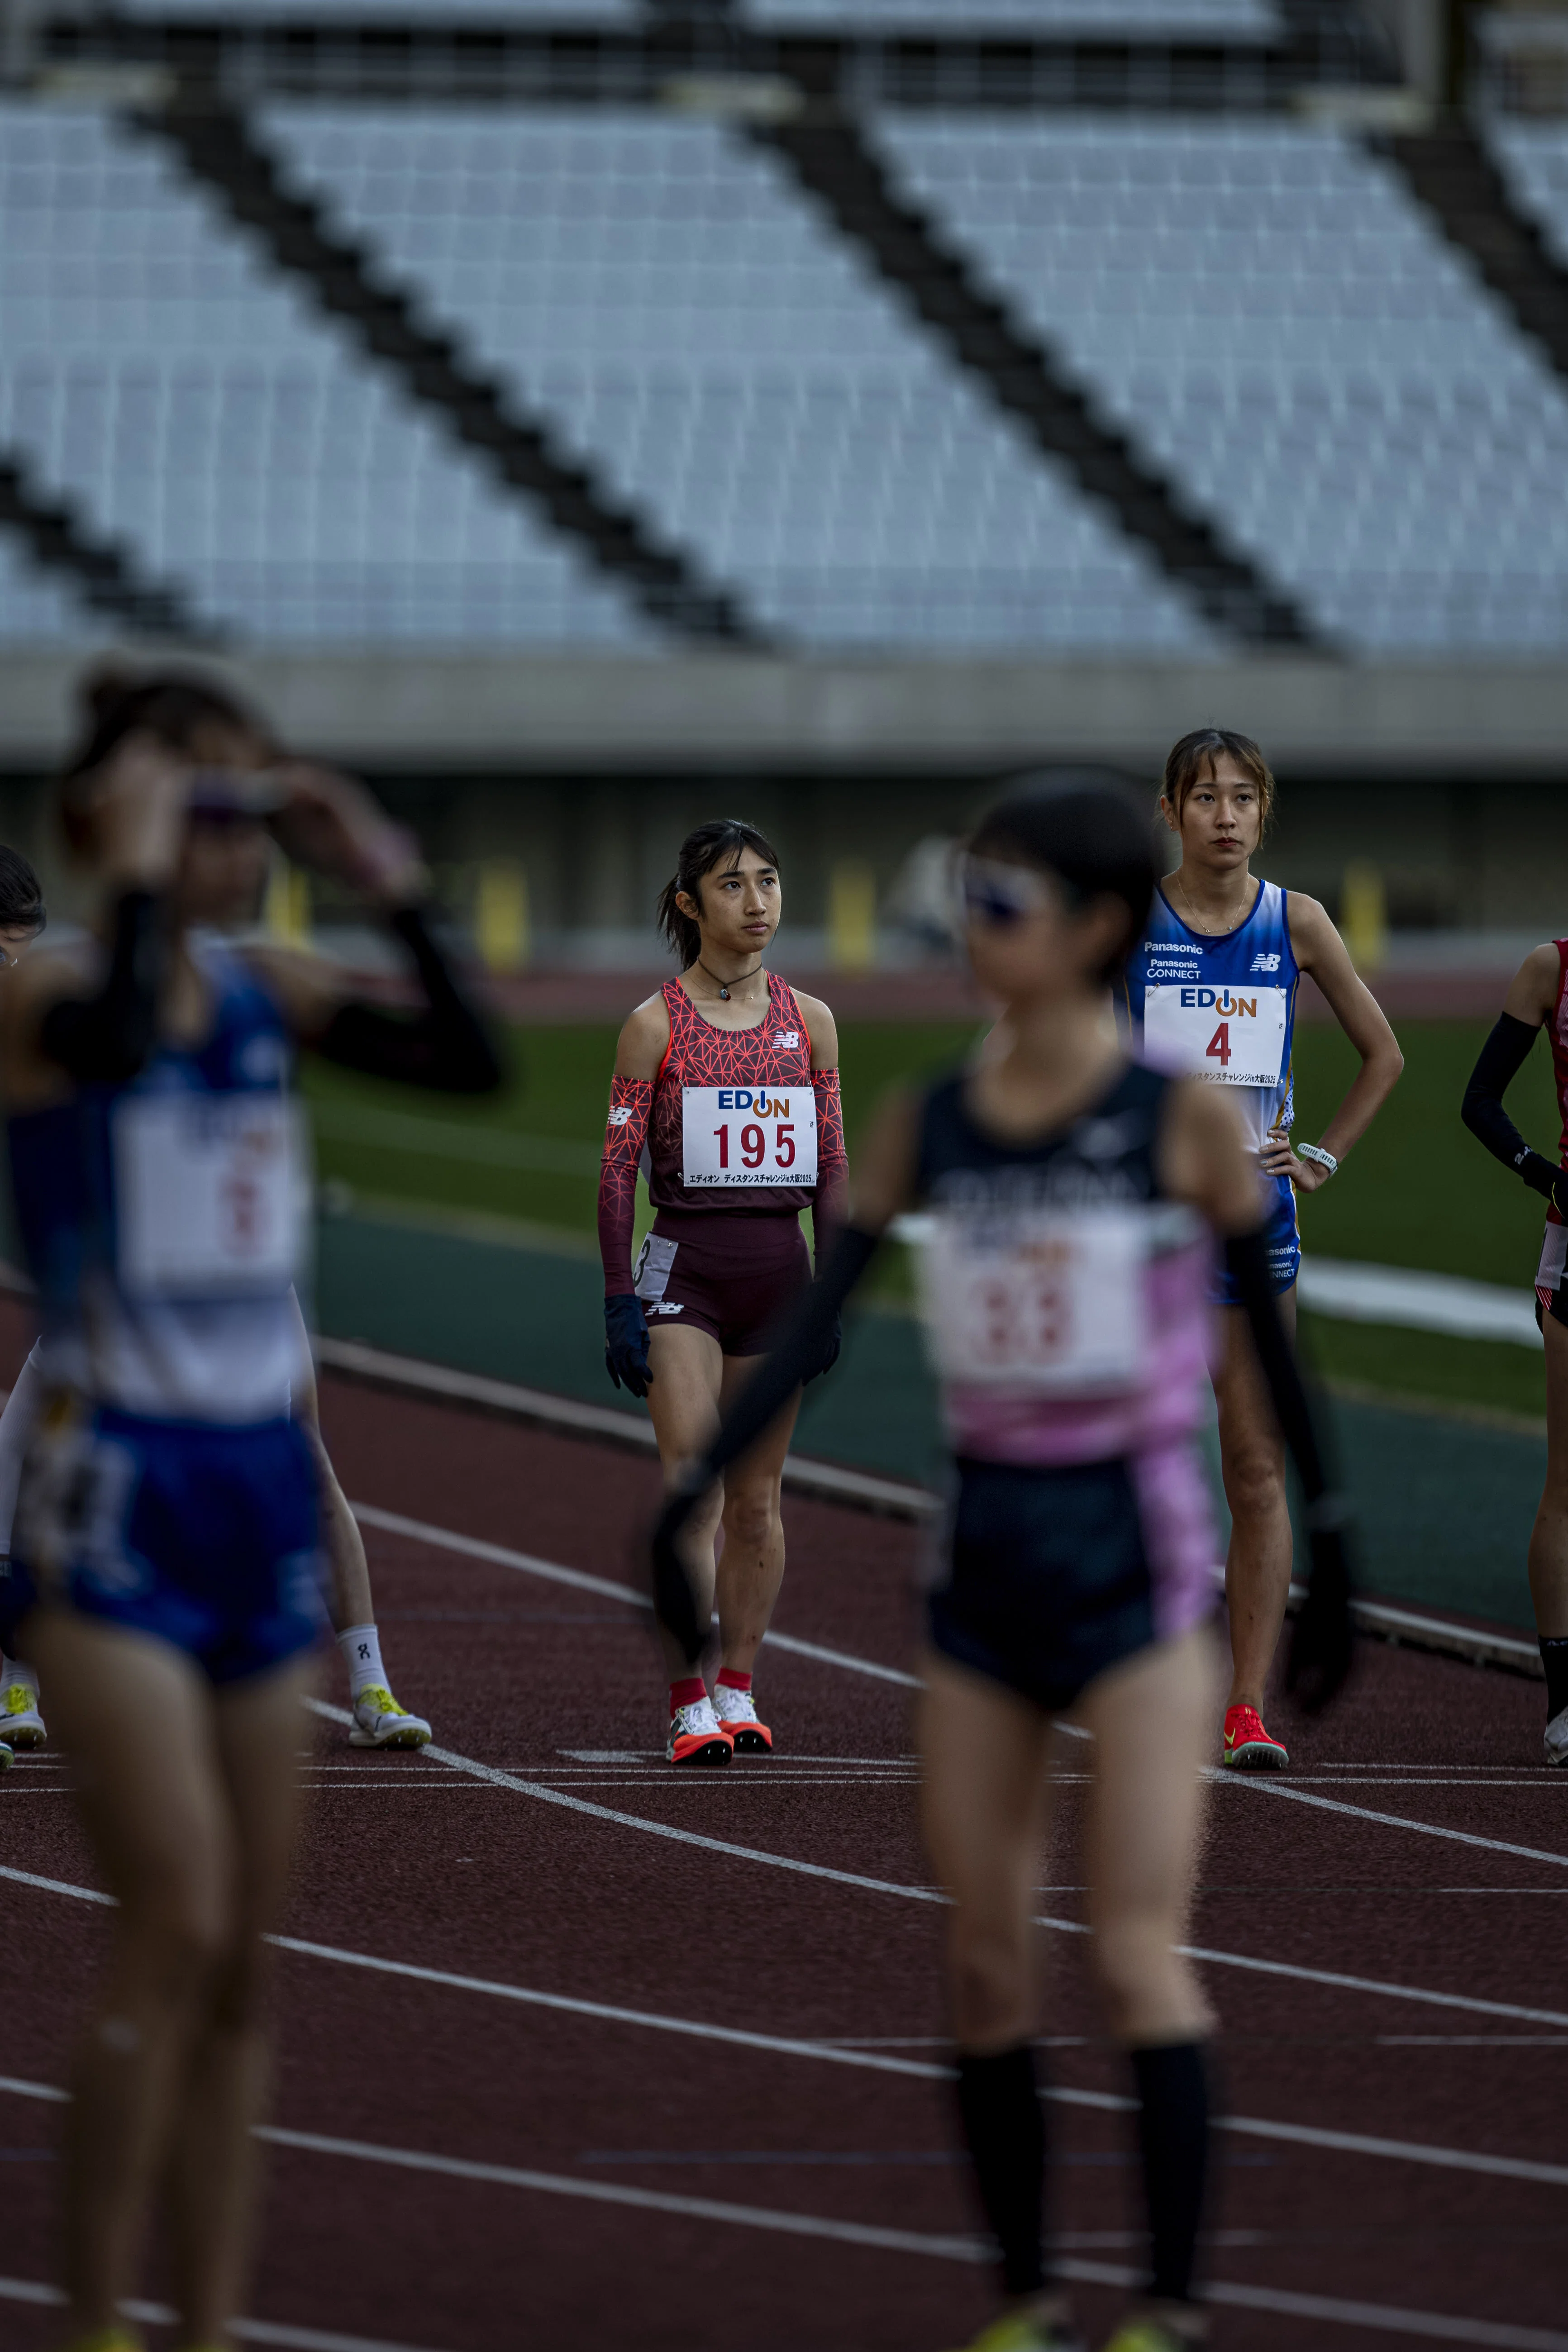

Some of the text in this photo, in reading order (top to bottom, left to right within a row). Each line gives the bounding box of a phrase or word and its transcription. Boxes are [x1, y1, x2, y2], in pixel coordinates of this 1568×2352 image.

[1144, 942, 1203, 955] Panasonic
[1147, 968, 1201, 979] CONNECT
[1151, 959, 1198, 968] Panasonic
[1180, 988, 1257, 1018] EDION
[1206, 1023, 1231, 1066] 4
[718, 1090, 789, 1118] EDION
[713, 1124, 796, 1168] 195
[690, 1174, 720, 1183] エディオン
